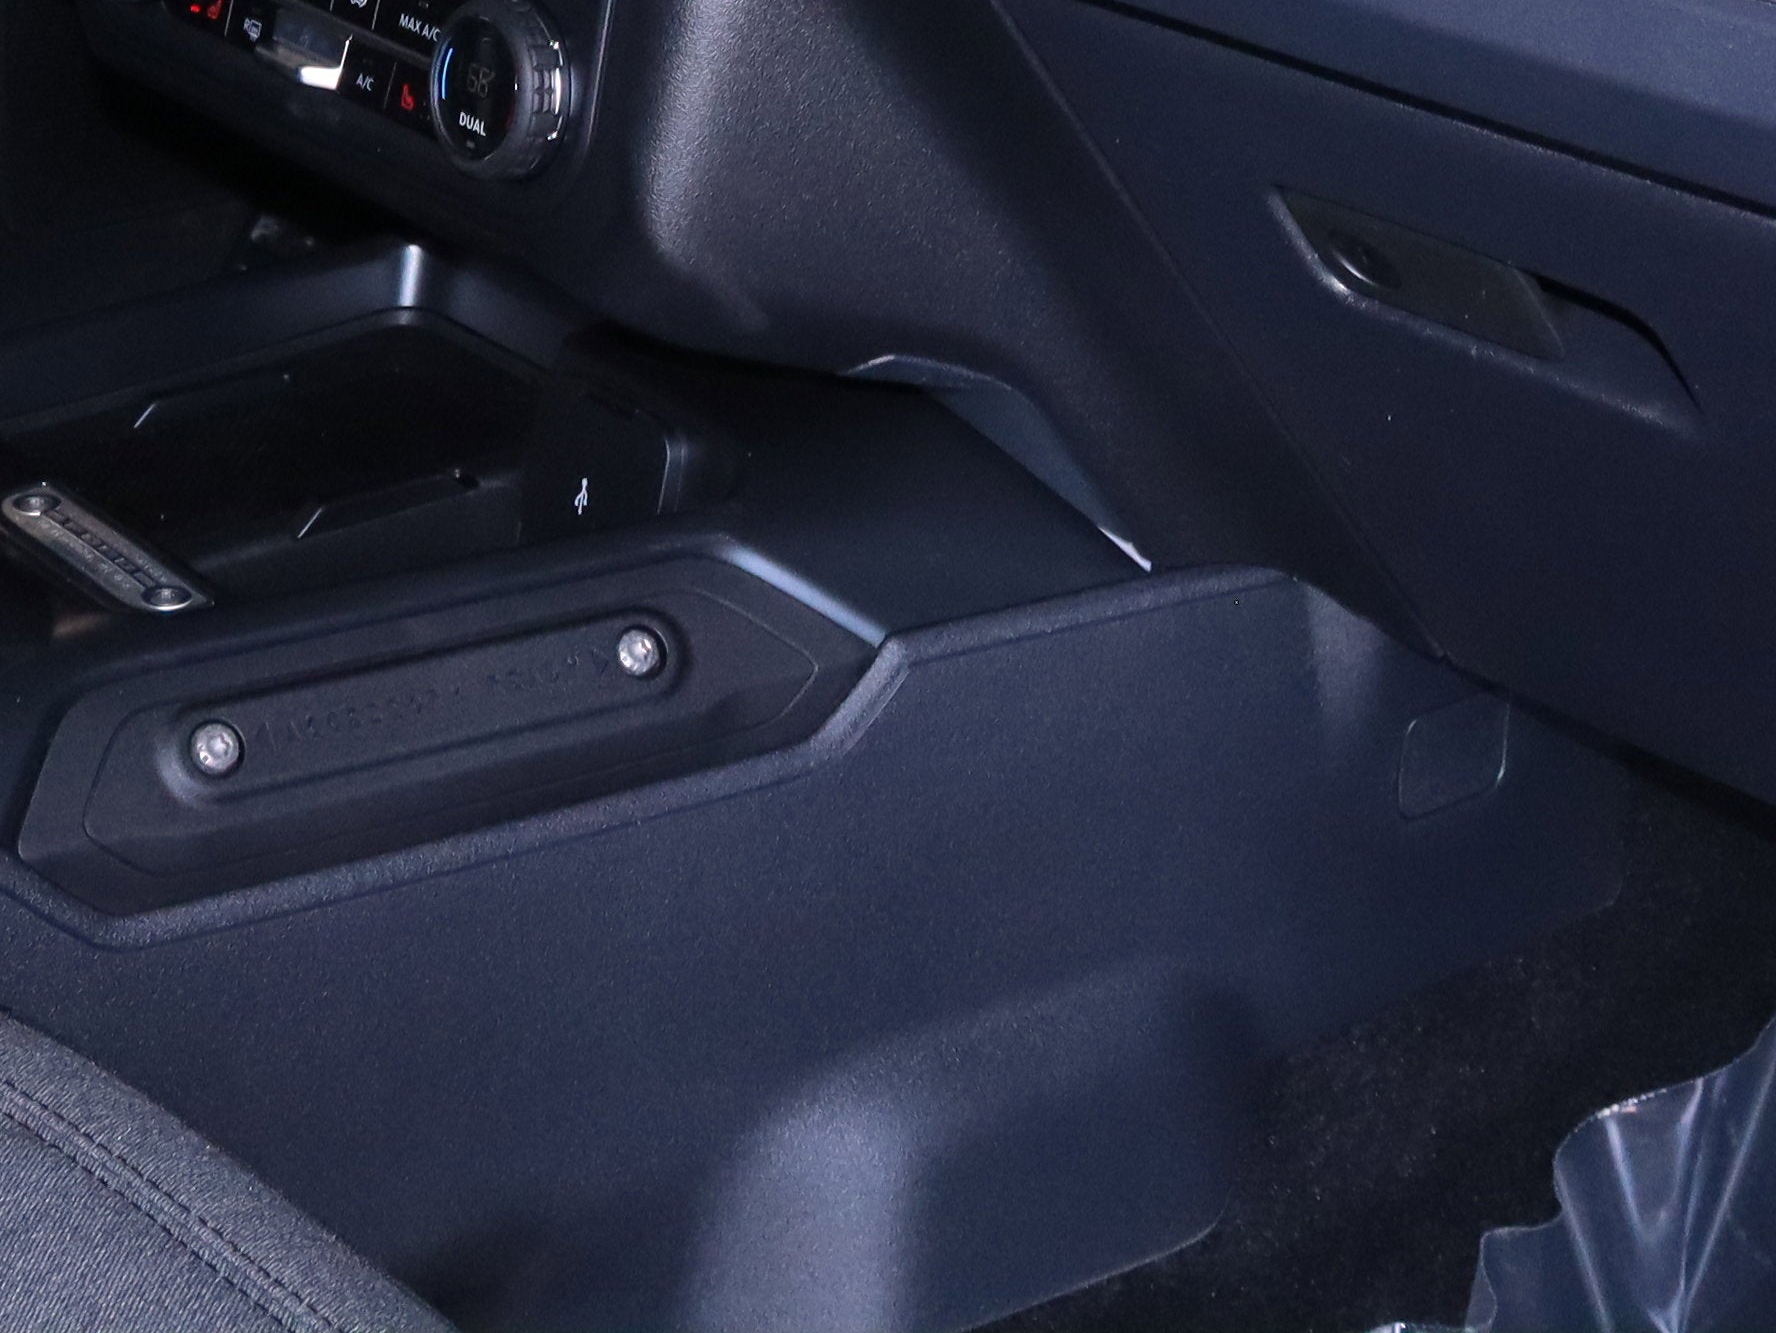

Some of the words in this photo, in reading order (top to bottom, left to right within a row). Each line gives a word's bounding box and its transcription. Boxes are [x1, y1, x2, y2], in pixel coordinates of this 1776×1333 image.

[398, 13, 421, 34] MAX
[422, 19, 441, 43] A/C
[356, 72, 375, 92] A/C
[458, 110, 487, 137] DUAL
